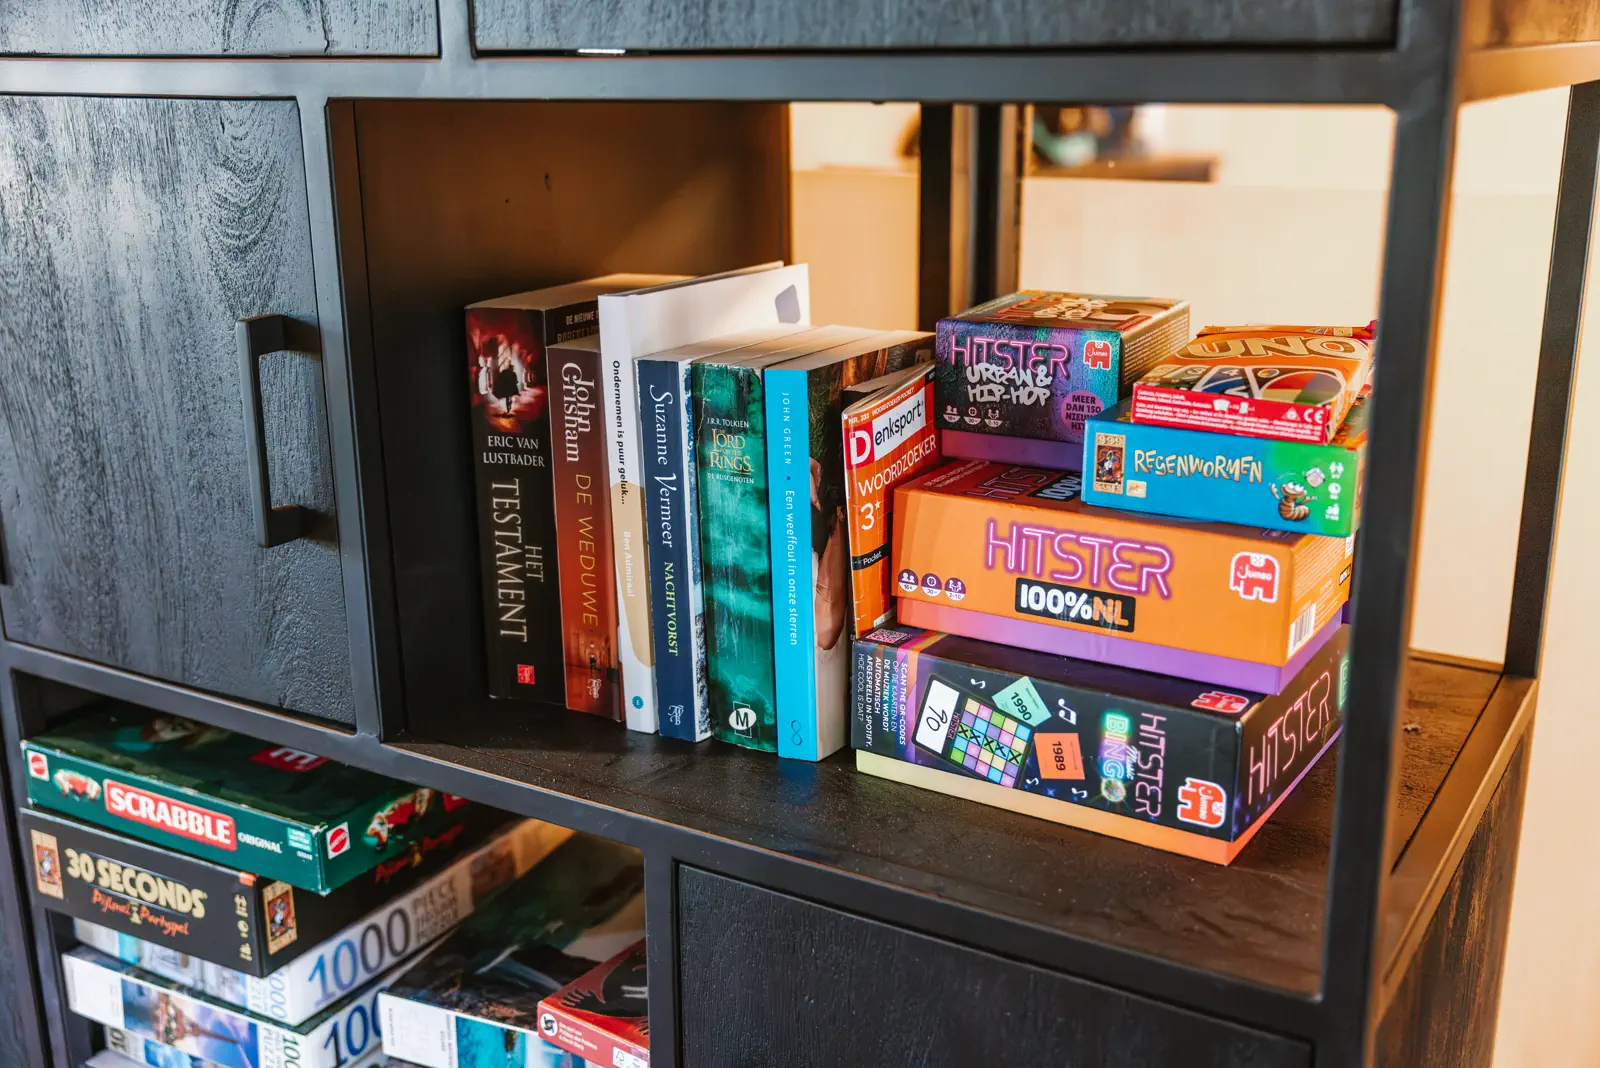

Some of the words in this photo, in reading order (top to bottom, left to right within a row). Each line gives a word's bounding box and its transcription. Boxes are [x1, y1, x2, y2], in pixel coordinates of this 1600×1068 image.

[950, 334, 1069, 377] HITSTER
[1184, 336, 1363, 358] UNO
[966, 363, 1034, 388] URBAN
[1036, 365, 1053, 387] &
[576, 379, 596, 433] John
[612, 360, 623, 428] Ondernemen
[782, 392, 791, 422] JOHN
[967, 384, 1051, 406] HIP-HOP
[1065, 403, 1085, 412] DAN
[1086, 404, 1102, 414] 150
[1071, 395, 1096, 404] MEER
[561, 362, 581, 463] Grisham
[650, 384, 674, 466] Suzanne
[722, 419, 749, 428] TOLKIEN
[487, 435, 514, 448] ERIC
[516, 437, 540, 449] VAN
[617, 430, 625, 439] is
[783, 428, 792, 465] GREEN
[851, 399, 922, 465] Denksport
[483, 452, 546, 468] LUSTBADER
[616, 440, 625, 466] puur
[858, 434, 937, 496] WOORDZOEKER
[1134, 449, 1263, 484] REGENWORMEN
[575, 474, 593, 506] DE
[785, 490, 795, 510] Een
[654, 472, 677, 548] Vermeer
[623, 531, 631, 549] Ben
[786, 512, 798, 564] weeffout
[492, 478, 528, 643] TESTAMENT
[524, 545, 545, 582] HET
[577, 516, 599, 627] WEDUWE
[624, 552, 635, 597] Admiraal
[788, 565, 797, 576] in
[863, 551, 882, 566] Pocket
[988, 520, 1169, 597] HITSTER
[788, 578, 797, 605] onze
[663, 562, 679, 656] NACHTVORST
[789, 608, 799, 645] sterren
[857, 653, 865, 670] HOE
[883, 659, 890, 670] DE
[892, 660, 899, 673] OP
[900, 662, 908, 686] SCAN
[857, 672, 865, 693] COOL
[865, 654, 873, 703] AFGESPEELD
[874, 656, 882, 714] AUTOMATISCH
[891, 674, 898, 683] DE
[865, 704, 873, 714] IN
[1010, 691, 1032, 721] 1990
[865, 715, 873, 747] SPOTIFY.
[891, 721, 897, 732] EN
[899, 702, 907, 746] QR-CODES
[1248, 671, 1331, 805] HITSTER
[1051, 740, 1066, 771] 1989
[1135, 712, 1168, 818] HITSTER
[109, 786, 232, 845] SCRABBLE
[237, 832, 283, 854] ORIGINAL
[64, 848, 95, 882] 30
[96, 858, 206, 919] SECONDS
[308, 907, 411, 1007] 1000
